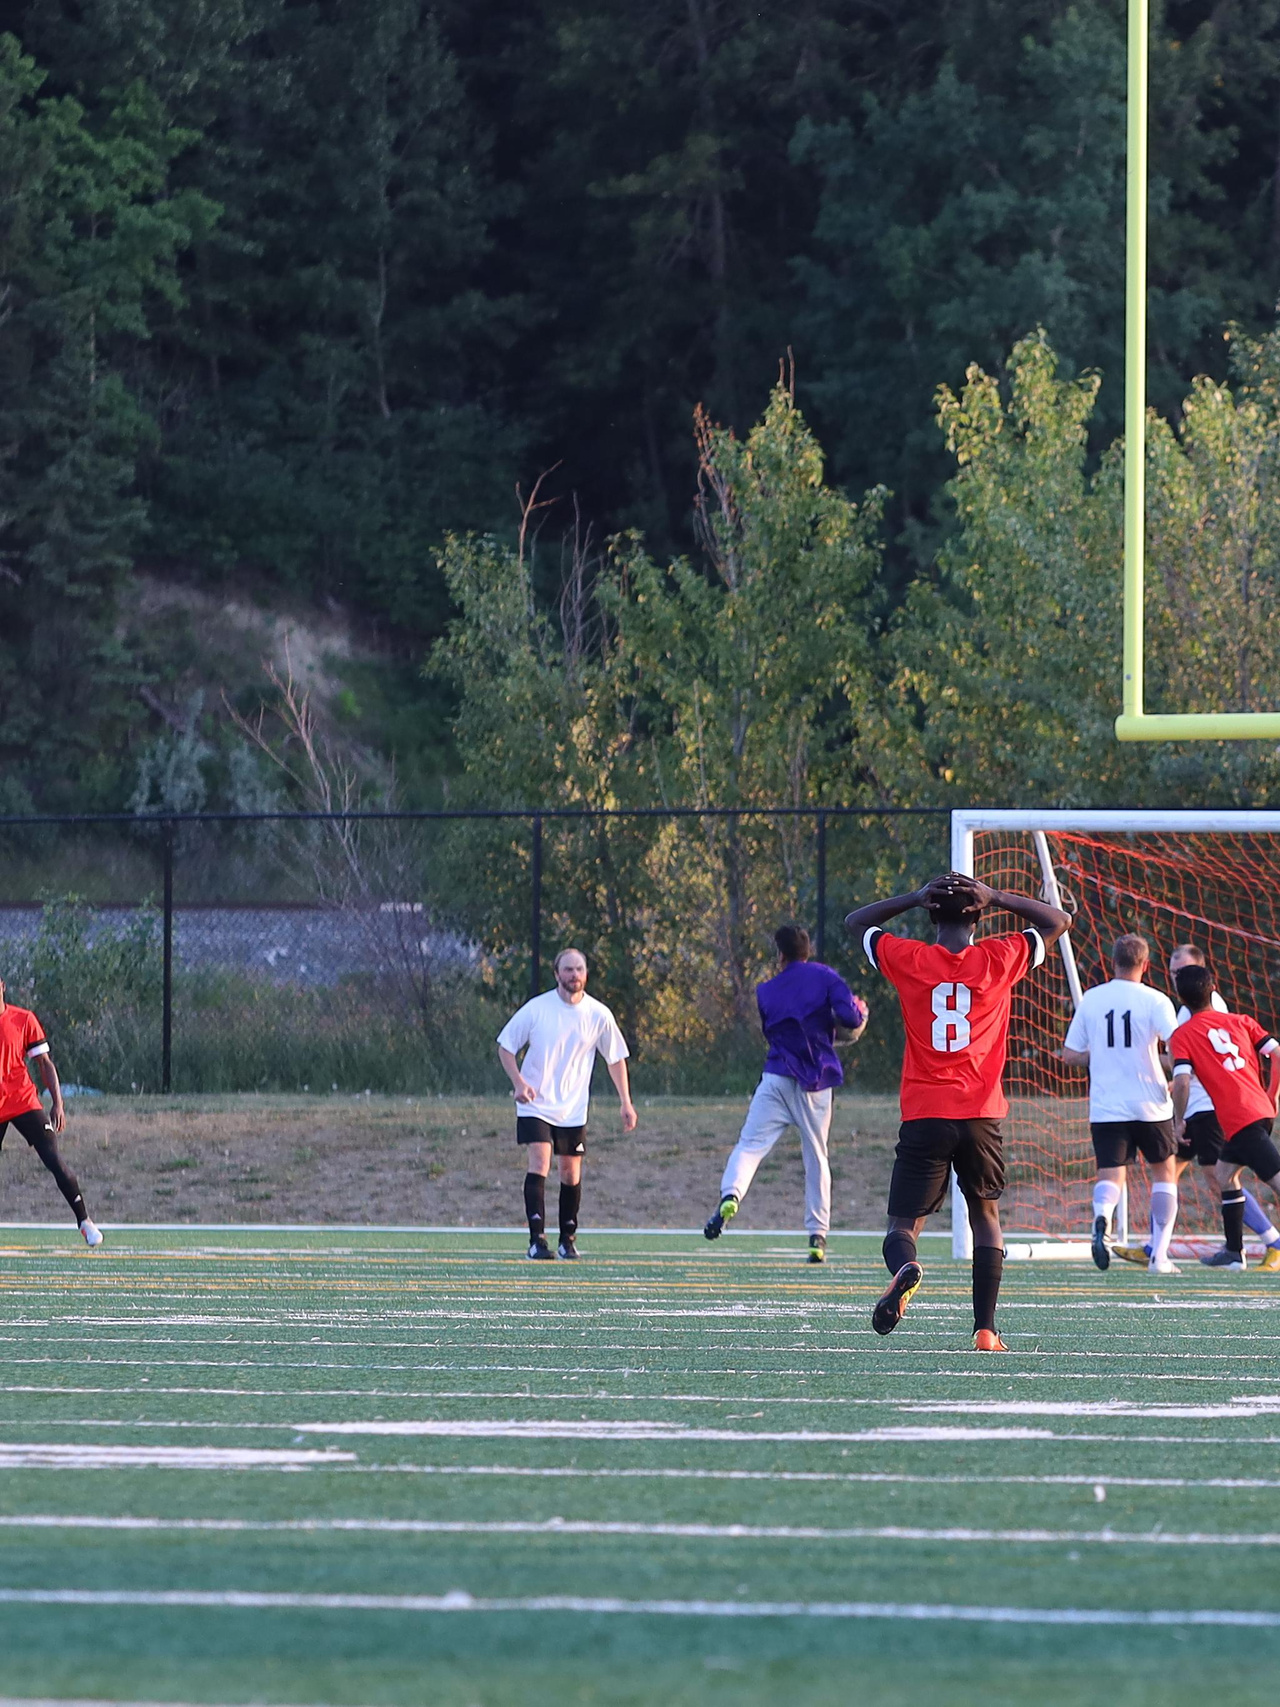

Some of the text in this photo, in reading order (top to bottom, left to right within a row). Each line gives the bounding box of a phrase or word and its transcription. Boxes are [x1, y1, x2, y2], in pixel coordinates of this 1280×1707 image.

[931, 982, 971, 1052] 8
[1105, 1009, 1132, 1048] 11
[1207, 1027, 1246, 1072] 9
